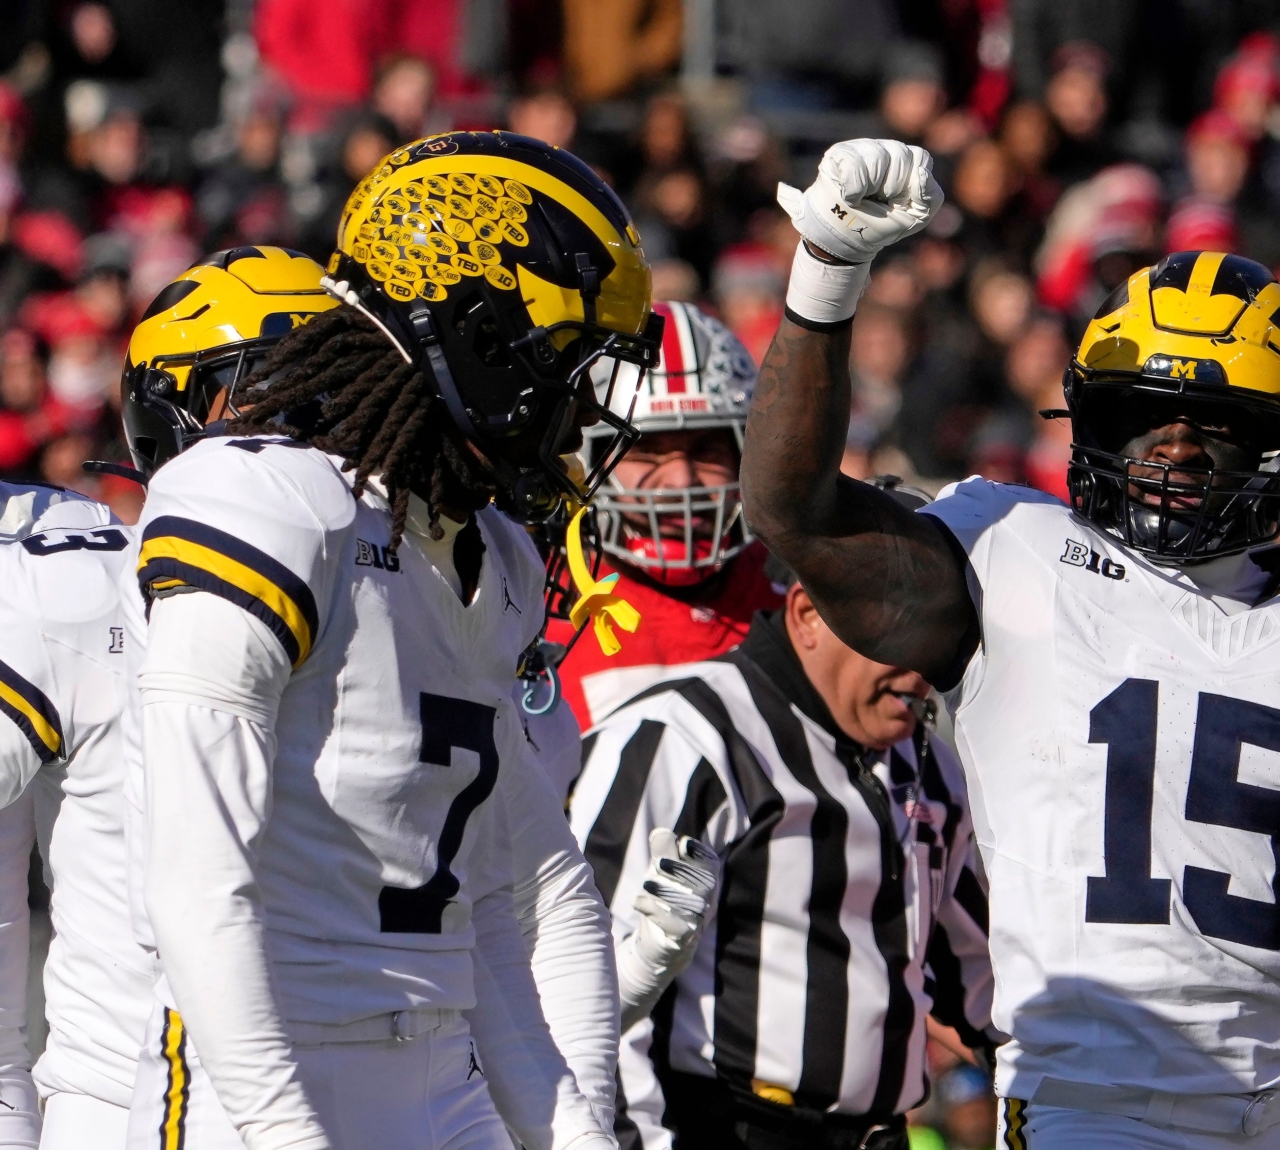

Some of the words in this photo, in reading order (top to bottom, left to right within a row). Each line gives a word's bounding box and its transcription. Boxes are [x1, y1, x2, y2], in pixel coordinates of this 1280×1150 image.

[477, 198, 496, 214] GAME
[831, 204, 848, 221] M
[504, 222, 524, 242] TED
[458, 257, 478, 272] TED
[390, 283, 411, 297] TED
[1170, 359, 1197, 379] M
[379, 691, 500, 934] 7
